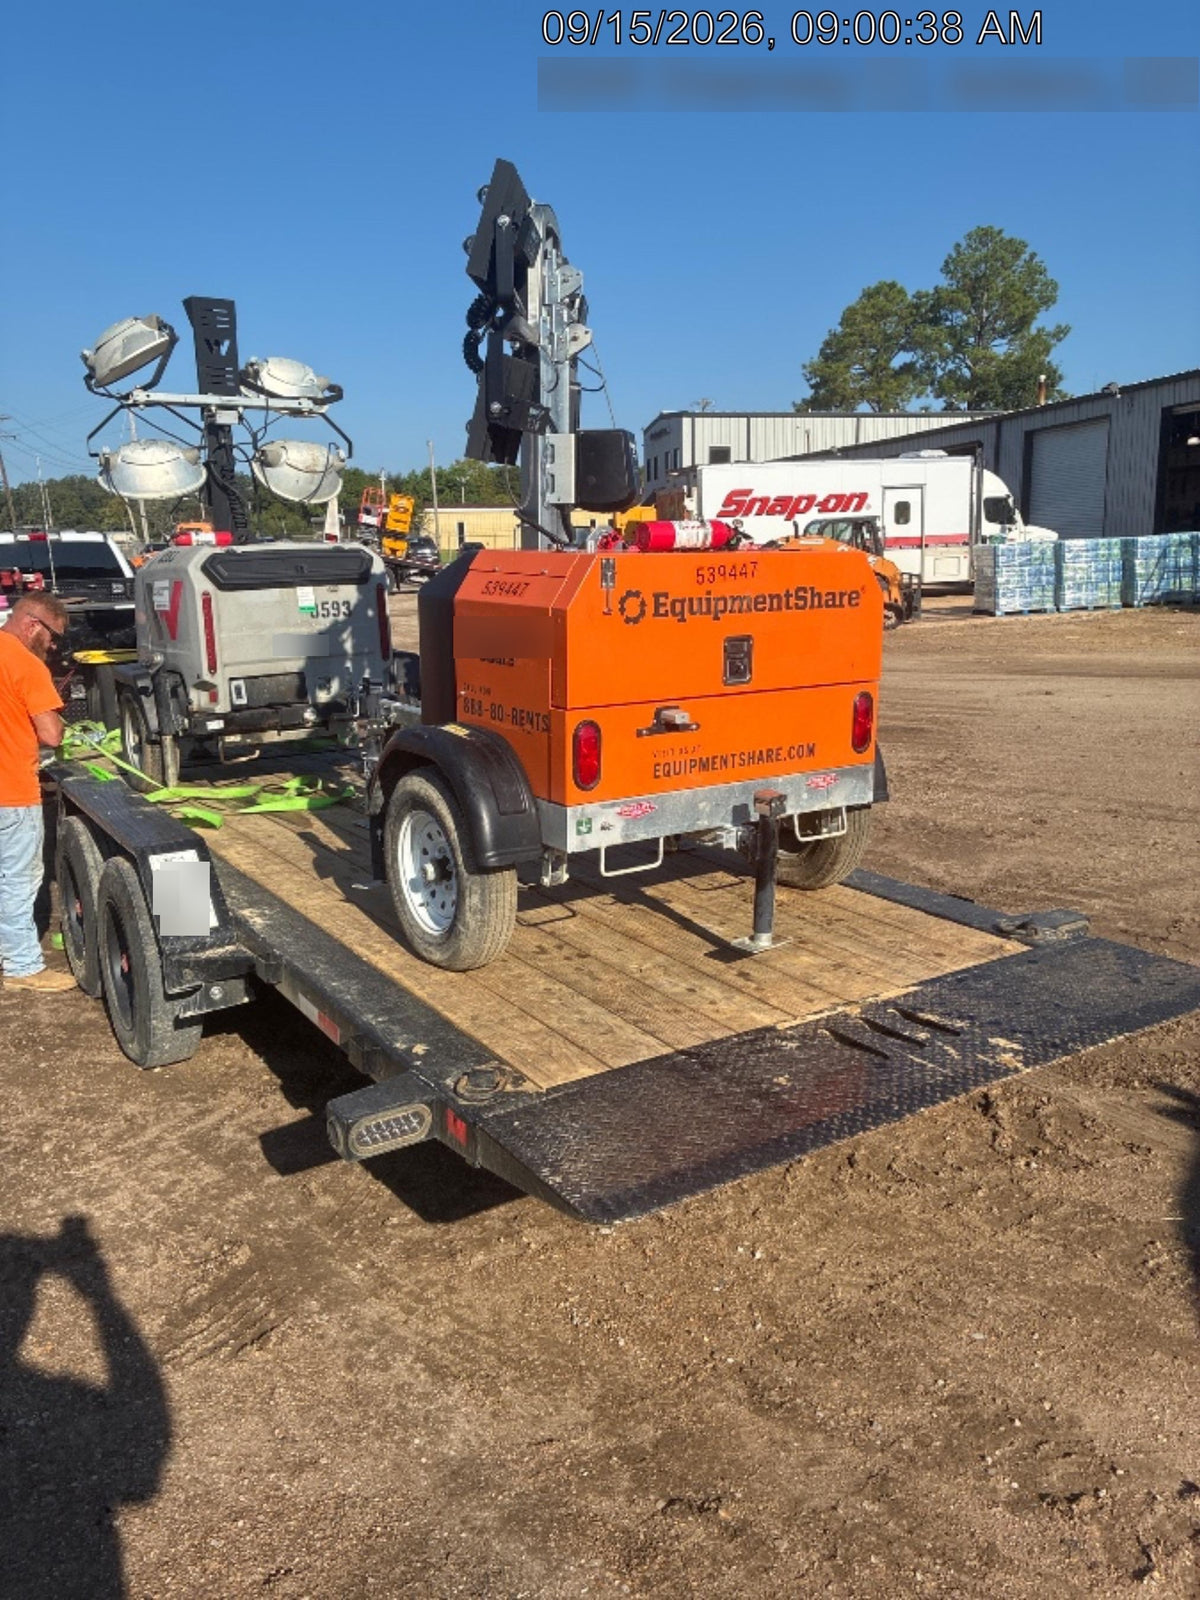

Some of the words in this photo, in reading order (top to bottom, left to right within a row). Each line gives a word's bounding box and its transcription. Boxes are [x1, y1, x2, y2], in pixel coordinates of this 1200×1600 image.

[717, 488, 869, 521] Snap-on
[481, 580, 530, 597] 539447
[696, 561, 758, 585] 539447
[653, 586, 861, 622] EquipmentShare
[653, 743, 816, 779] EQUIPMENTSHARE.COM
